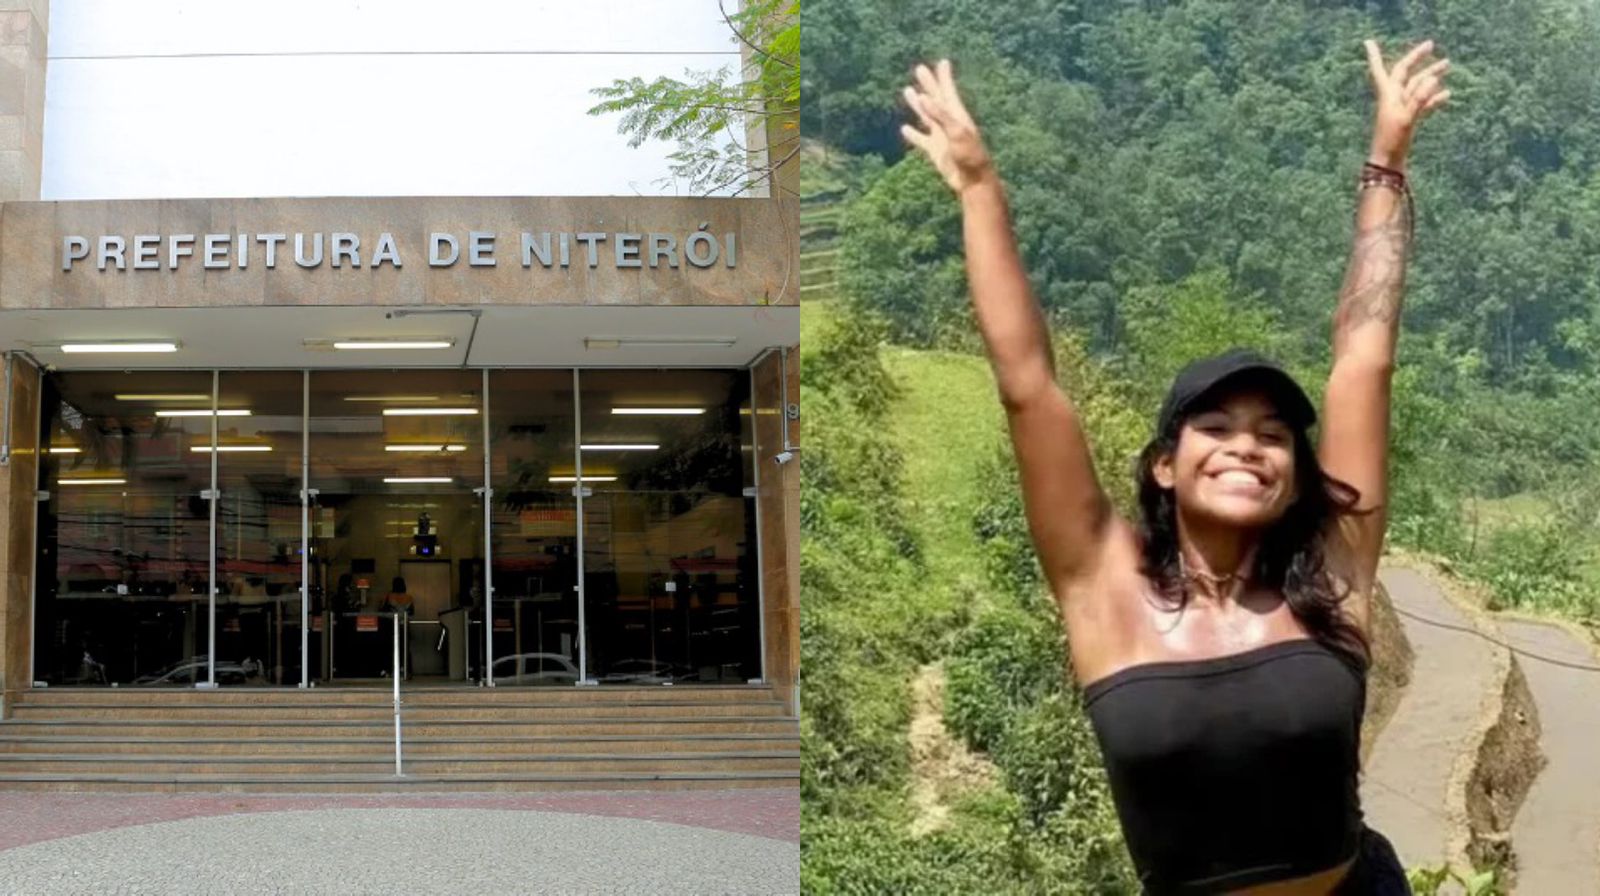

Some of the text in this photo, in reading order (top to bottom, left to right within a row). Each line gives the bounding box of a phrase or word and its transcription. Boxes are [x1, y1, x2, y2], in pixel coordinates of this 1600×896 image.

[62, 223, 737, 271] PREFEITURA DE NITERÓI
